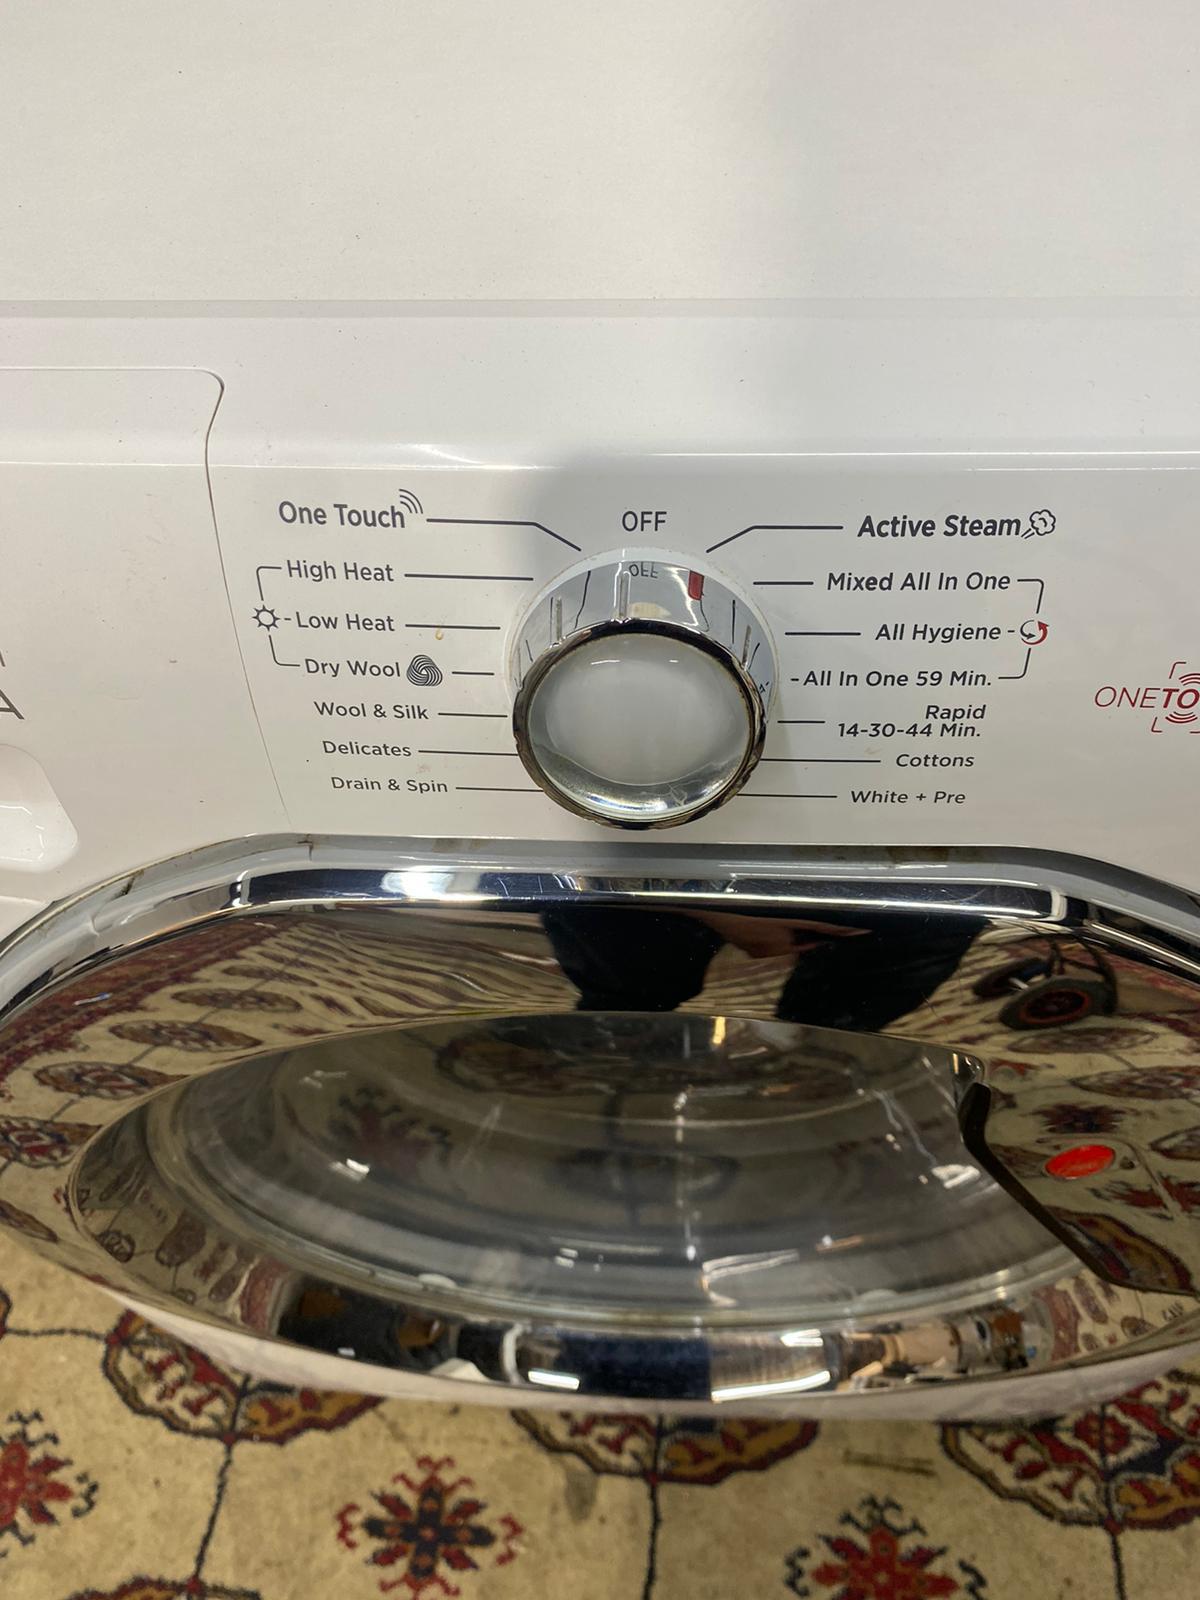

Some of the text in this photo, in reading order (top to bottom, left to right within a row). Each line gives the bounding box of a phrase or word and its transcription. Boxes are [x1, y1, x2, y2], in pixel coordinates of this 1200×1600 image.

[278, 500, 406, 528] One Touch
[622, 510, 667, 532] OFF
[857, 514, 1021, 538] Active Steam
[286, 559, 395, 582] High Heat
[827, 571, 1011, 592] Mixed All In One
[295, 611, 395, 632] Low Heat
[875, 624, 1001, 644] All Hygiene
[305, 658, 401, 678] Dry Wool
[803, 670, 992, 688] All In One 59 Min.
[313, 701, 429, 720] Wool & Silk
[925, 705, 986, 722] Rapid
[837, 723, 981, 738] 14-30-44 Min.
[322, 740, 412, 757] Delicates
[896, 753, 975, 768] Cottons
[331, 776, 448, 794] Drain & Spin
[850, 790, 966, 805] White + Pre
